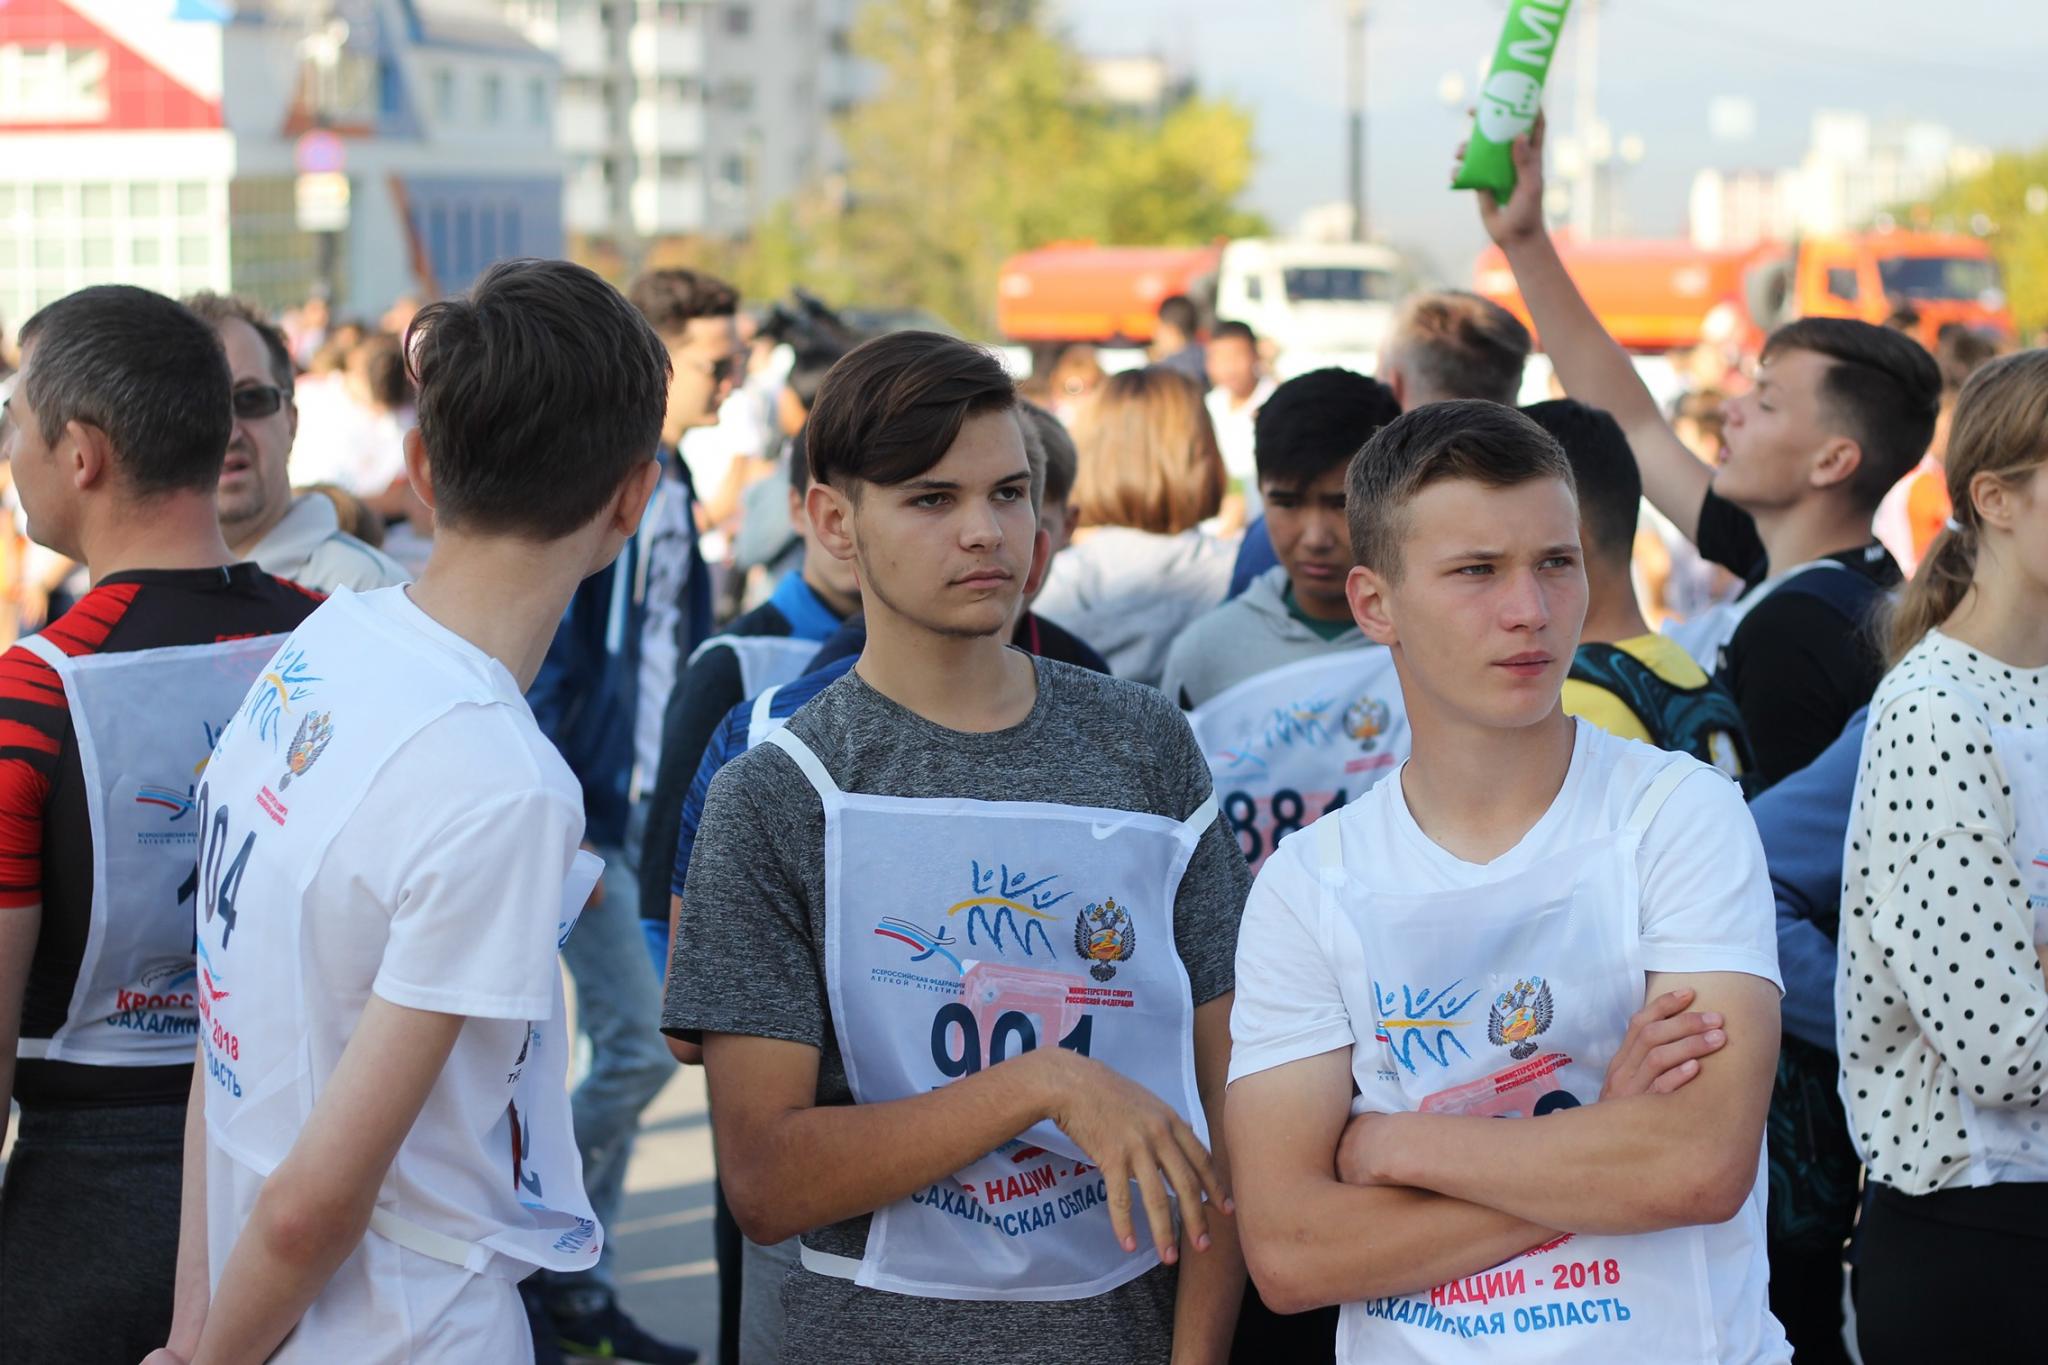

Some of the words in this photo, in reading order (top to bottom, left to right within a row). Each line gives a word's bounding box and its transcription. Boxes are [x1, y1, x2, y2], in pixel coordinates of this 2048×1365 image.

[212, 1018, 239, 1061] 2018
[985, 1163, 1057, 1205] НАЦИИ
[1058, 1178, 1109, 1219] ОБЛАС
[1430, 1268, 1526, 1308] НАЦИИ
[1551, 1258, 1621, 1290] 2018
[1513, 1298, 1631, 1329] ОБЛАСТЬ
